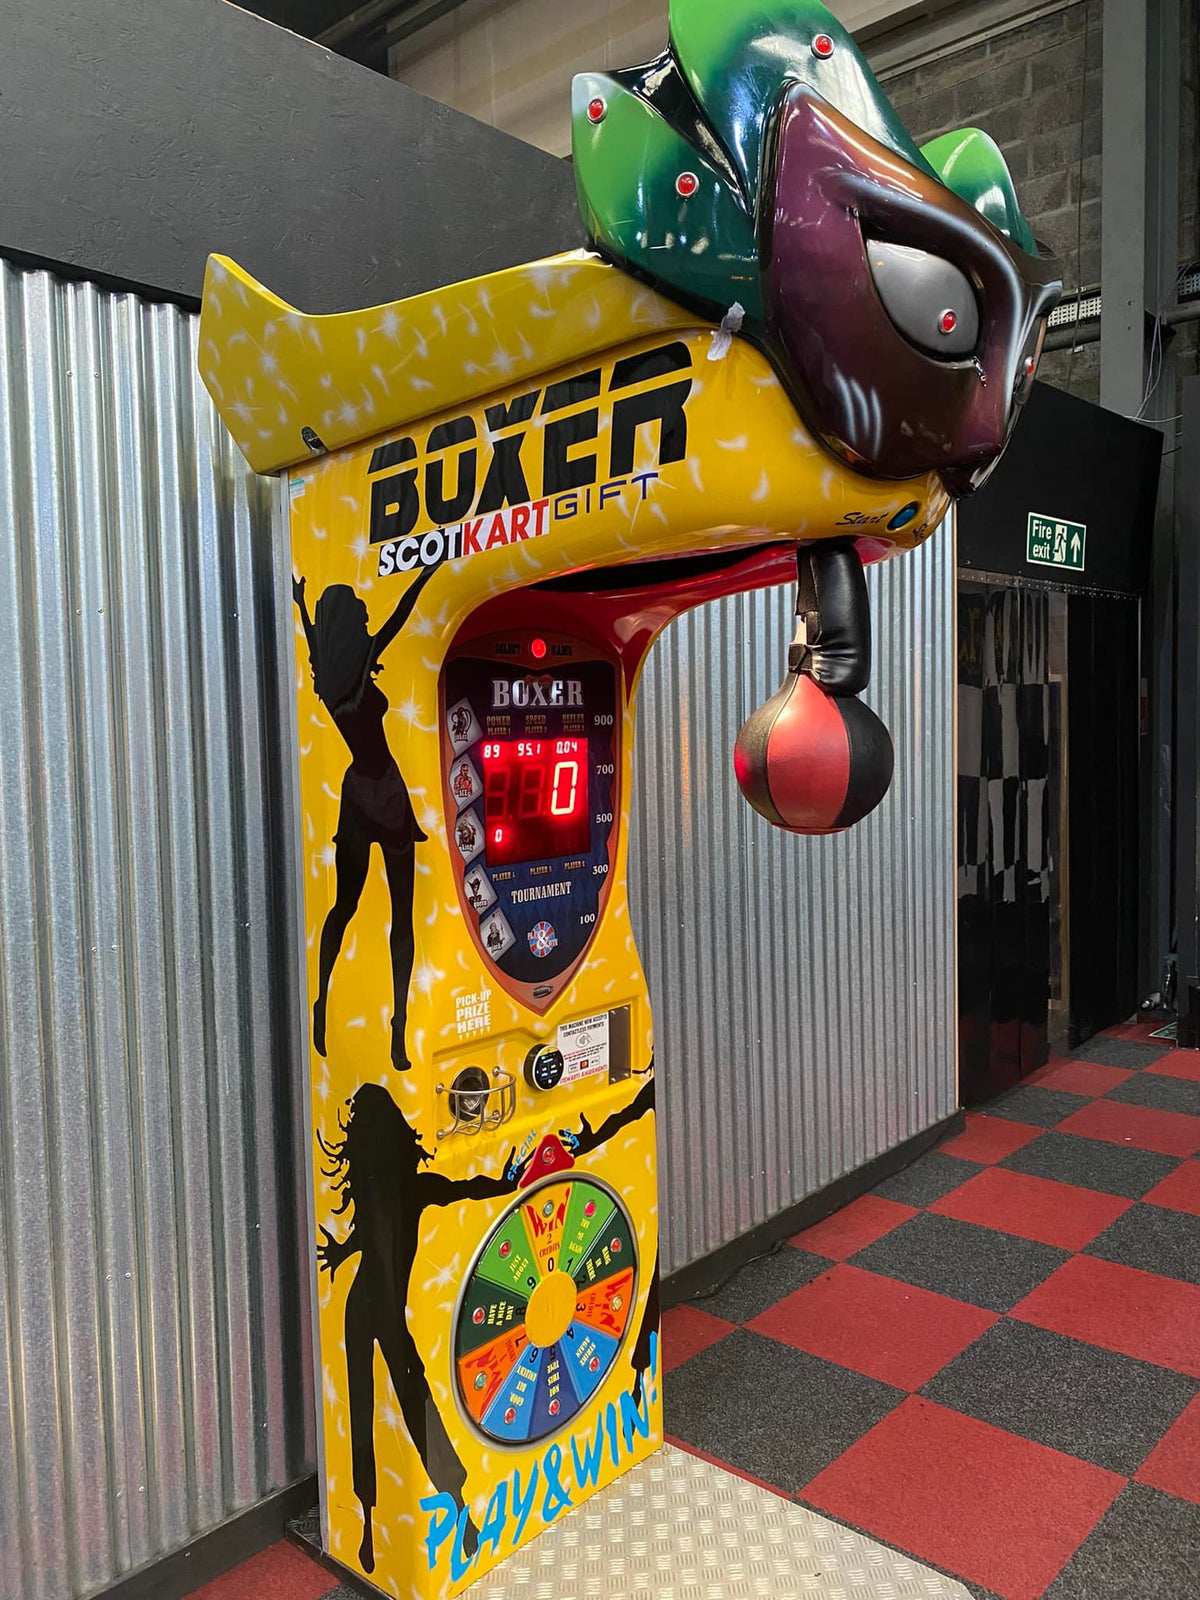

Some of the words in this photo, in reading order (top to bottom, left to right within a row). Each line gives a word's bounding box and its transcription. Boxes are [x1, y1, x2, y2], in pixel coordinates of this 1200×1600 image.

[367, 341, 693, 544] BOXER
[554, 473, 659, 520] GIFT
[835, 512, 889, 525] Start
[1032, 519, 1052, 540] Fire
[379, 498, 549, 577] SCOTKART
[1032, 542, 1050, 560] exit
[493, 679, 583, 707] BOXER
[487, 715, 511, 726] POWER
[525, 714, 547, 725] SPEED
[594, 715, 613, 726] 900
[484, 744, 500, 758] 89
[596, 764, 614, 775] 700
[551, 761, 578, 815] 0
[596, 812, 613, 823] 500
[495, 829, 502, 842] 0
[529, 866, 548, 876] PLAYER
[564, 861, 581, 870] PLAYER
[592, 864, 608, 875] 300
[492, 871, 511, 882] PLAYER
[511, 881, 572, 904] TOURNAMENT
[580, 913, 595, 925] 100
[456, 989, 492, 1008] PICK-UP
[456, 1001, 490, 1022] PRIZE
[457, 1014, 491, 1034] HERE
[507, 1129, 537, 1181] SPECIAL
[526, 1187, 570, 1238] WIN
[546, 1233, 552, 1244] 2
[509, 1254, 522, 1272] JUST
[512, 1258, 529, 1282] ABOUT
[548, 1257, 554, 1272] 0
[566, 1257, 573, 1272] 1
[527, 1276, 537, 1290] 9
[487, 1304, 497, 1325] HAVE
[497, 1301, 507, 1318] NICE
[506, 1305, 514, 1320] DAY
[516, 1307, 526, 1316] 8
[576, 1303, 586, 1312] 3
[566, 1327, 574, 1339] 4
[515, 1334, 527, 1348] 7
[575, 1336, 591, 1358] AGAIN
[529, 1347, 538, 1363] 6
[549, 1346, 556, 1360] 5
[547, 1360, 559, 1374] TIME
[547, 1372, 560, 1386] THIS
